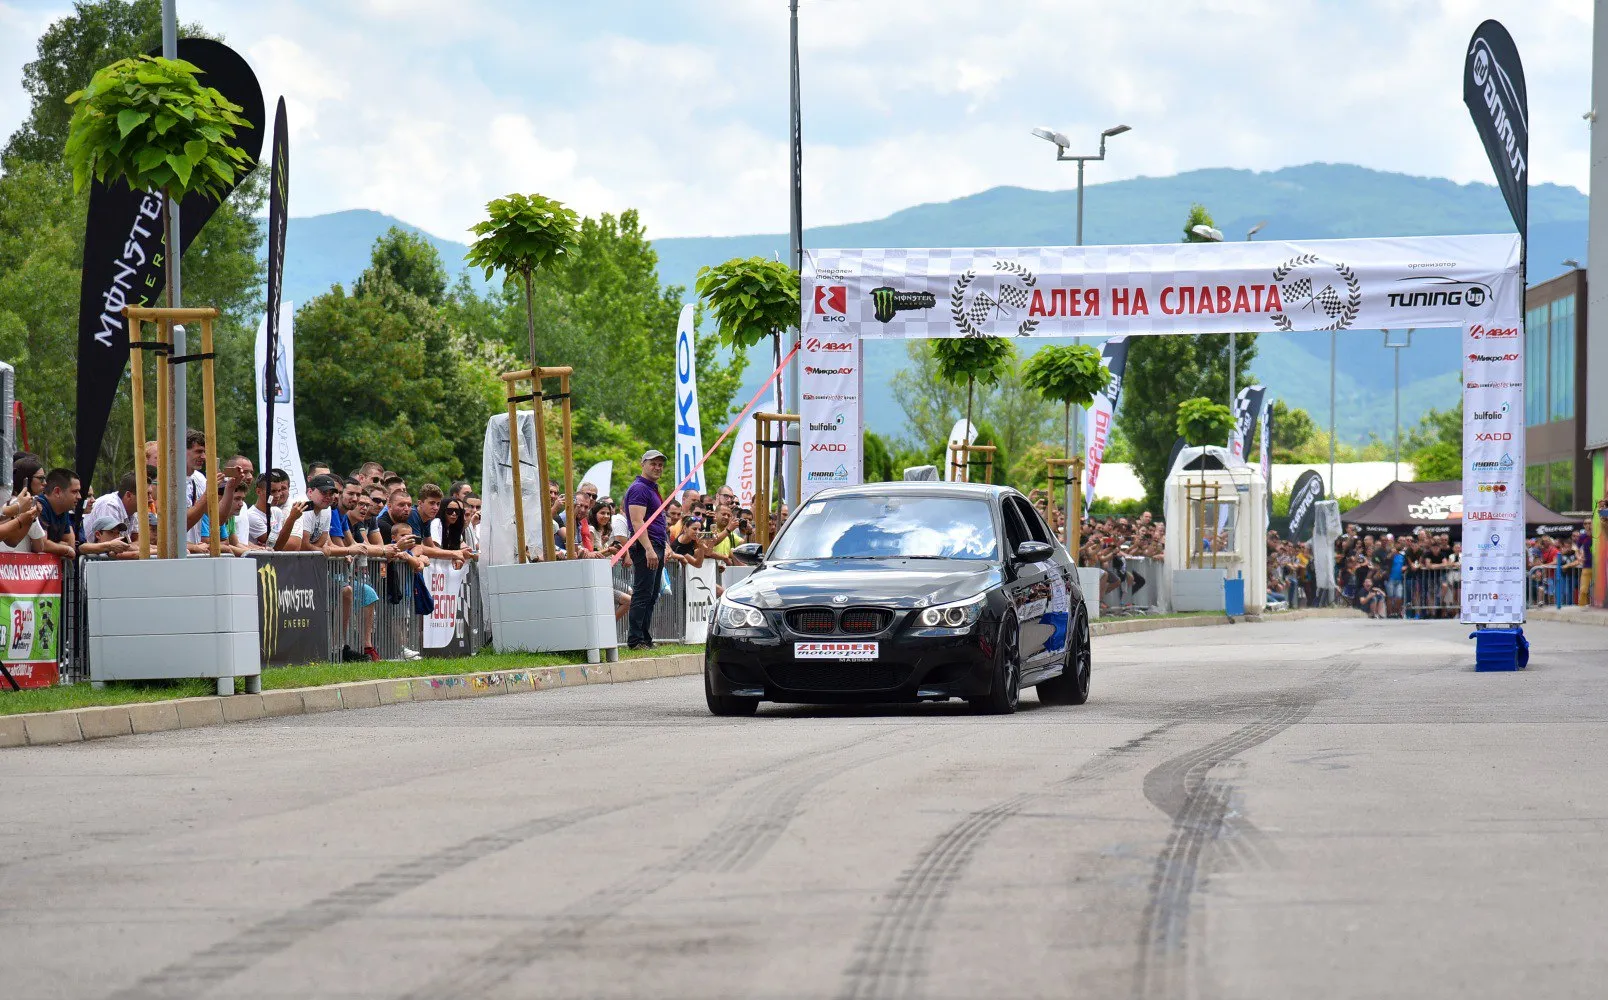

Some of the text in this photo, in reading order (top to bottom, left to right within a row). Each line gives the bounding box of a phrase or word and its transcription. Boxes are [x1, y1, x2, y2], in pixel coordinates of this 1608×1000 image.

[1029, 284, 1283, 317] АЛЕЯ НА СЛАВАТА
[1388, 291, 1462, 307] TUNING
[677, 330, 700, 491] EKO
[1474, 411, 1503, 420] bulfolio
[809, 422, 837, 431] bulfolio
[1475, 433, 1512, 441] XADO
[1467, 511, 1493, 519] LAURA
[431, 573, 445, 592] EKO
[278, 584, 315, 614] MONSTER
[283, 618, 311, 628] ENERGY
[797, 643, 876, 651] ZENDER
